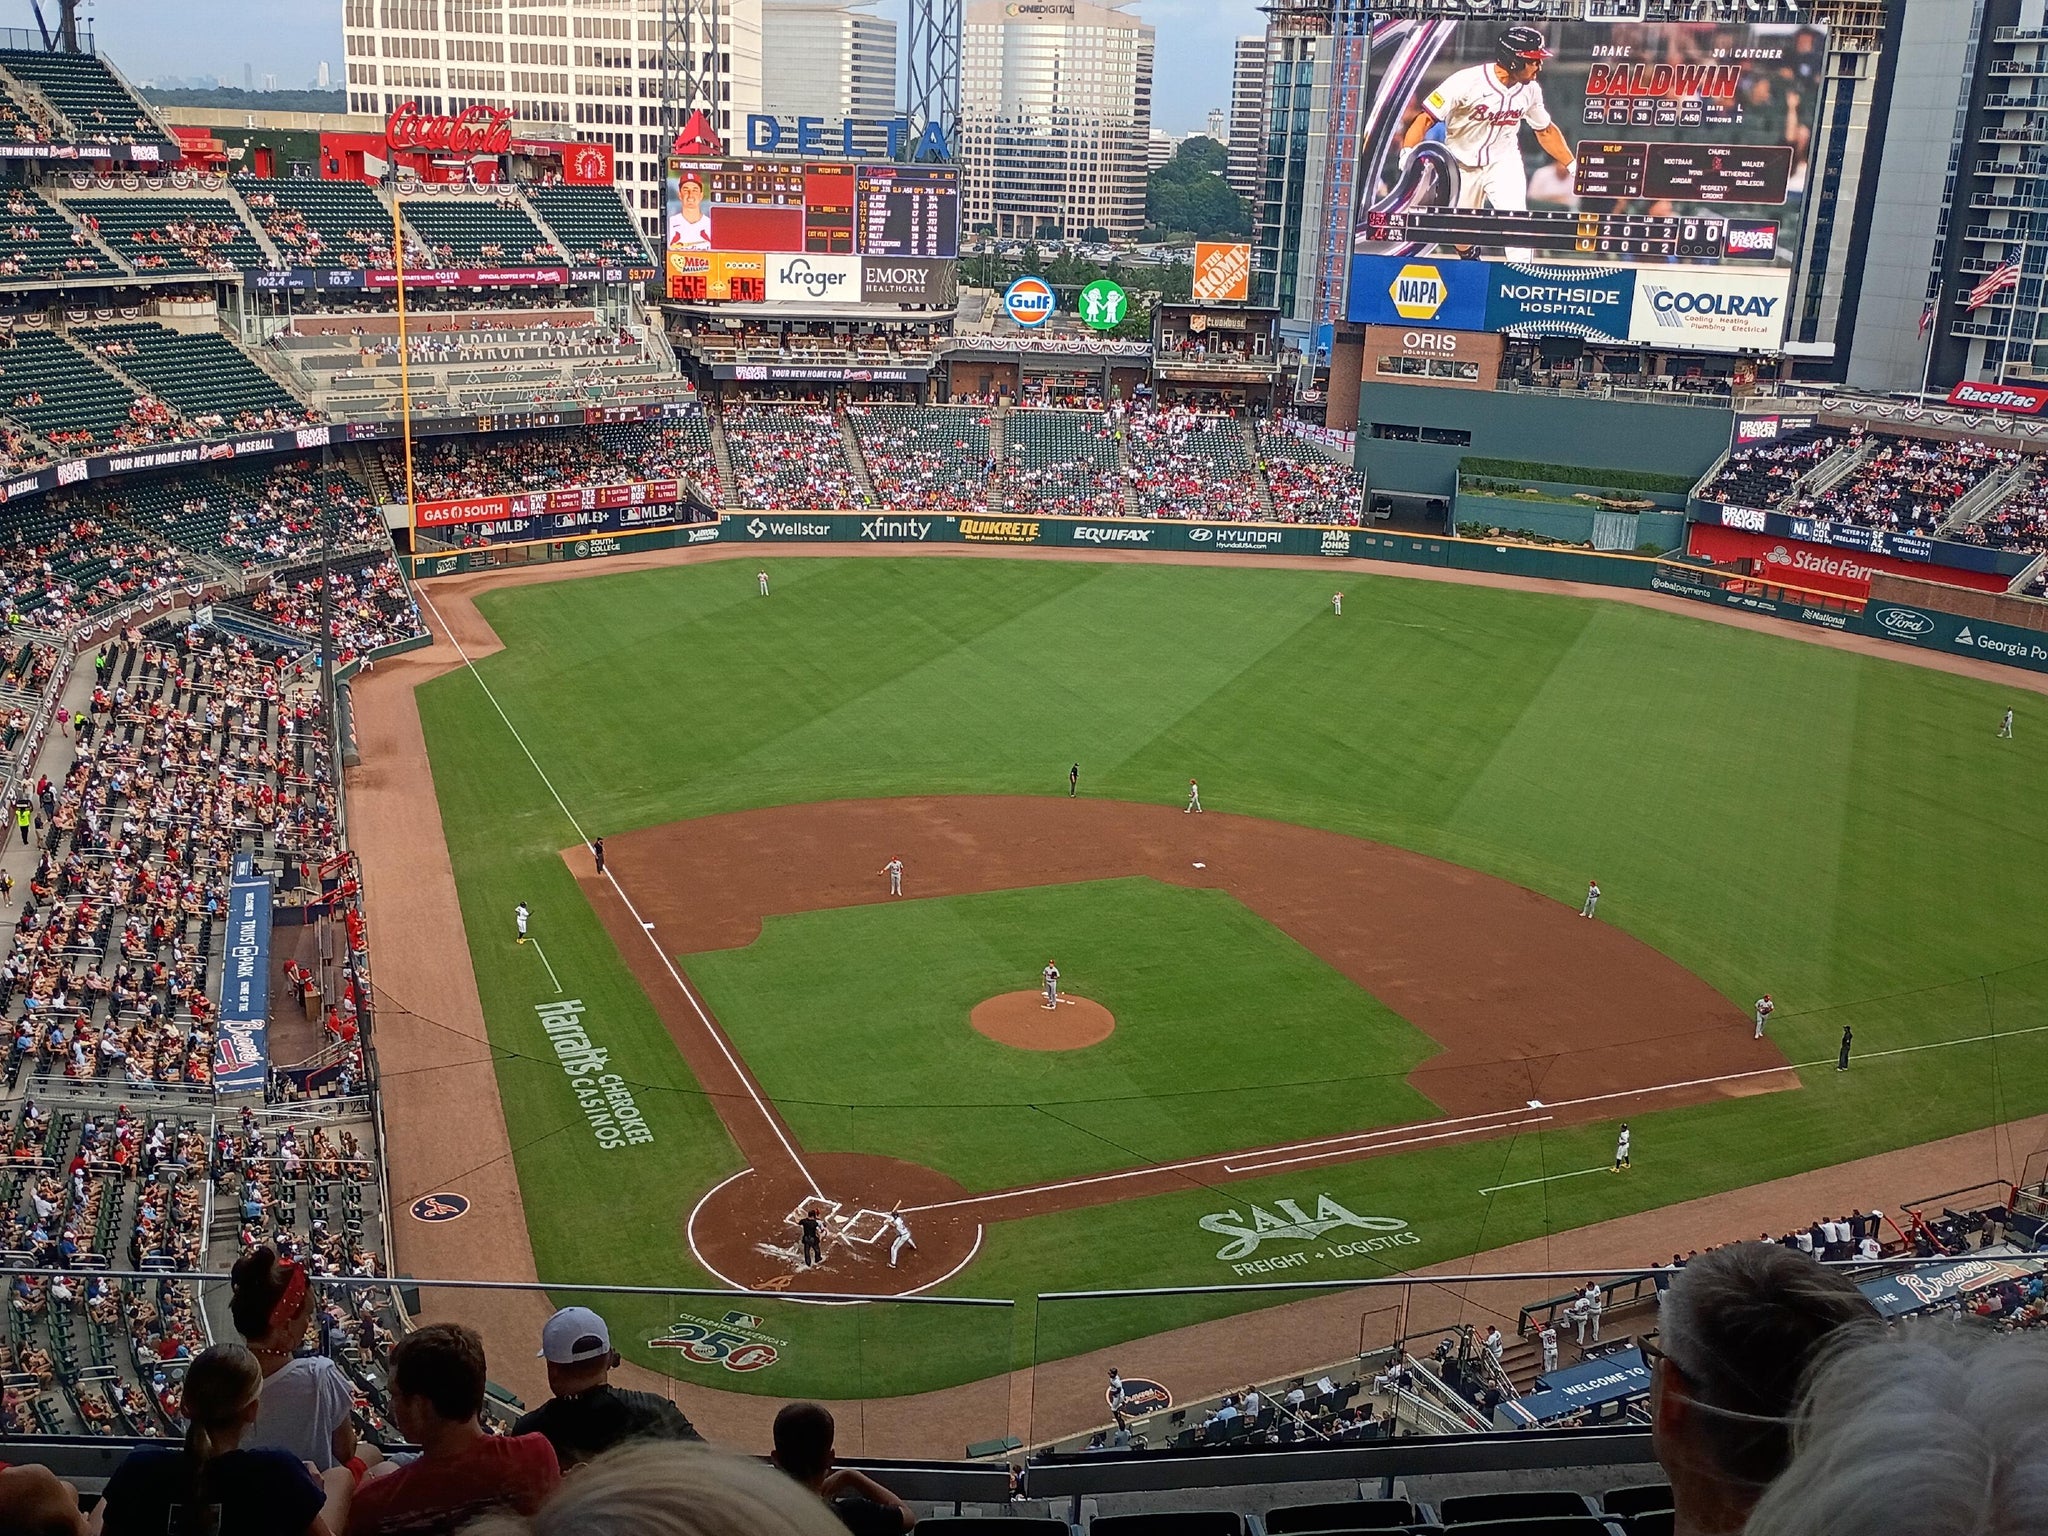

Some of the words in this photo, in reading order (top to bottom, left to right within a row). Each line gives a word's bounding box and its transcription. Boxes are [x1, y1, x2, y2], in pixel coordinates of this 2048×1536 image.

[1018, 5, 1074, 14] ONEDIGITAL
[1592, 46, 1631, 57] DRAKE
[1712, 48, 1725, 58] 30
[1734, 49, 1783, 59] CATCHER
[1586, 63, 1742, 98] BALDWIN
[1614, 112, 1622, 120] 14
[746, 114, 950, 159] DELTA
[14, 147, 34, 156] HOME
[35, 148, 48, 156] FOR
[80, 148, 111, 157] BASEBALL
[859, 181, 869, 190] 30
[1391, 214, 1403, 222] STL
[1684, 225, 1696, 240] 0
[1706, 226, 1718, 242] 0
[1730, 230, 1774, 240] BRAVES
[1730, 238, 1772, 249] VISION
[1201, 249, 1224, 272] THE
[435, 272, 460, 280] COSTA
[572, 272, 587, 280] 7:24
[588, 272, 600, 280] PM
[629, 270, 656, 279] $9,777
[780, 258, 846, 297] Kroger
[866, 268, 929, 285] EMORY
[1193, 244, 1250, 298] HOME
[257, 278, 285, 286] 102.4
[673, 276, 705, 292] 542
[866, 284, 926, 293] HEALTHCARE
[1215, 266, 1250, 299] DEPOT
[1398, 280, 1437, 304] NAPA
[1500, 285, 1620, 304] NORTHSIDE
[1008, 292, 1050, 309] Gulf
[1654, 291, 1779, 317] COOLRAY
[1520, 302, 1595, 316] HOSPITAL
[1206, 318, 1246, 329] CLUBHOUSE
[1684, 314, 1713, 323] Cooling
[1720, 318, 1749, 326] Heating
[1690, 323, 1726, 332] Plumbing
[1732, 325, 1767, 333] Electrical
[1403, 332, 1456, 349] ORIS
[736, 372, 767, 380] VISION
[772, 369, 790, 377] YOUR
[791, 370, 807, 378] NEW
[807, 370, 827, 378] HOME
[828, 370, 842, 378] FOR
[873, 371, 906, 379] BASEBALL
[1956, 386, 2036, 408] RaceTrac
[676, 409, 685, 417] 19
[1740, 421, 1777, 431] BRAVES
[296, 428, 328, 441] BRAVES
[1740, 429, 1776, 438] VISION
[297, 435, 330, 448] VISION
[109, 458, 132, 471] YOUR
[134, 456, 154, 468] NEW
[156, 452, 180, 466] HOME
[181, 449, 198, 463] FOR
[236, 438, 274, 454] BASEBALL
[57, 460, 87, 474] BRAVES
[58, 468, 88, 484] VISION
[8, 477, 39, 497] BASEBALL
[630, 484, 646, 493] WSH
[530, 494, 547, 502] CWS
[581, 490, 596, 498] TEX
[630, 492, 645, 500] BOS
[512, 501, 527, 513] AL
[530, 501, 545, 510] BAL
[581, 497, 596, 505] CLE
[424, 508, 449, 521] GAS
[464, 503, 503, 517] SOUTH
[641, 505, 674, 519] MLB+
[1722, 506, 1766, 520] BRAVES
[495, 520, 530, 534] MLB+
[770, 522, 830, 536] Wellstar
[861, 517, 931, 540] xfinity
[1722, 514, 1765, 532] VISION
[1794, 522, 1810, 536] NL
[1814, 521, 1830, 531] MIA
[1073, 527, 1150, 543] EQUIFAX
[1216, 530, 1282, 543] HYUNDAI
[1322, 530, 1350, 541] PAPA
[1813, 530, 1830, 538] COL
[1833, 535, 1860, 544] FREELAND
[1872, 531, 1884, 539] SF
[590, 538, 614, 546] SOUTH
[1321, 541, 1350, 550] JOHNS
[1870, 539, 1883, 548] AZ
[1892, 536, 1920, 546] MCDONALD
[590, 544, 620, 552] COLLEGE
[1898, 546, 1919, 555] GALLEN
[1812, 611, 1846, 626] National
[1885, 609, 1924, 632] Ford
[1978, 635, 2027, 656] Georgia
[239, 920, 256, 945] TRUIST
[236, 956, 254, 978] PARK
[222, 1018, 266, 1065] Braves
[571, 1078, 626, 1150] CASINOS
[598, 1074, 655, 1145] CHEROKEE
[1199, 1194, 1408, 1260] SAIA
[1232, 1252, 1308, 1277] FREIGHT
[1327, 1232, 1421, 1259] LOGISTICS
[1896, 1261, 1993, 1304] Braves
[680, 1313, 740, 1334] CELEBRATING
[739, 1330, 789, 1347] AMERICA'S
[1562, 1372, 1628, 1396] WELCOME
[1625, 1367, 1645, 1377] TO
